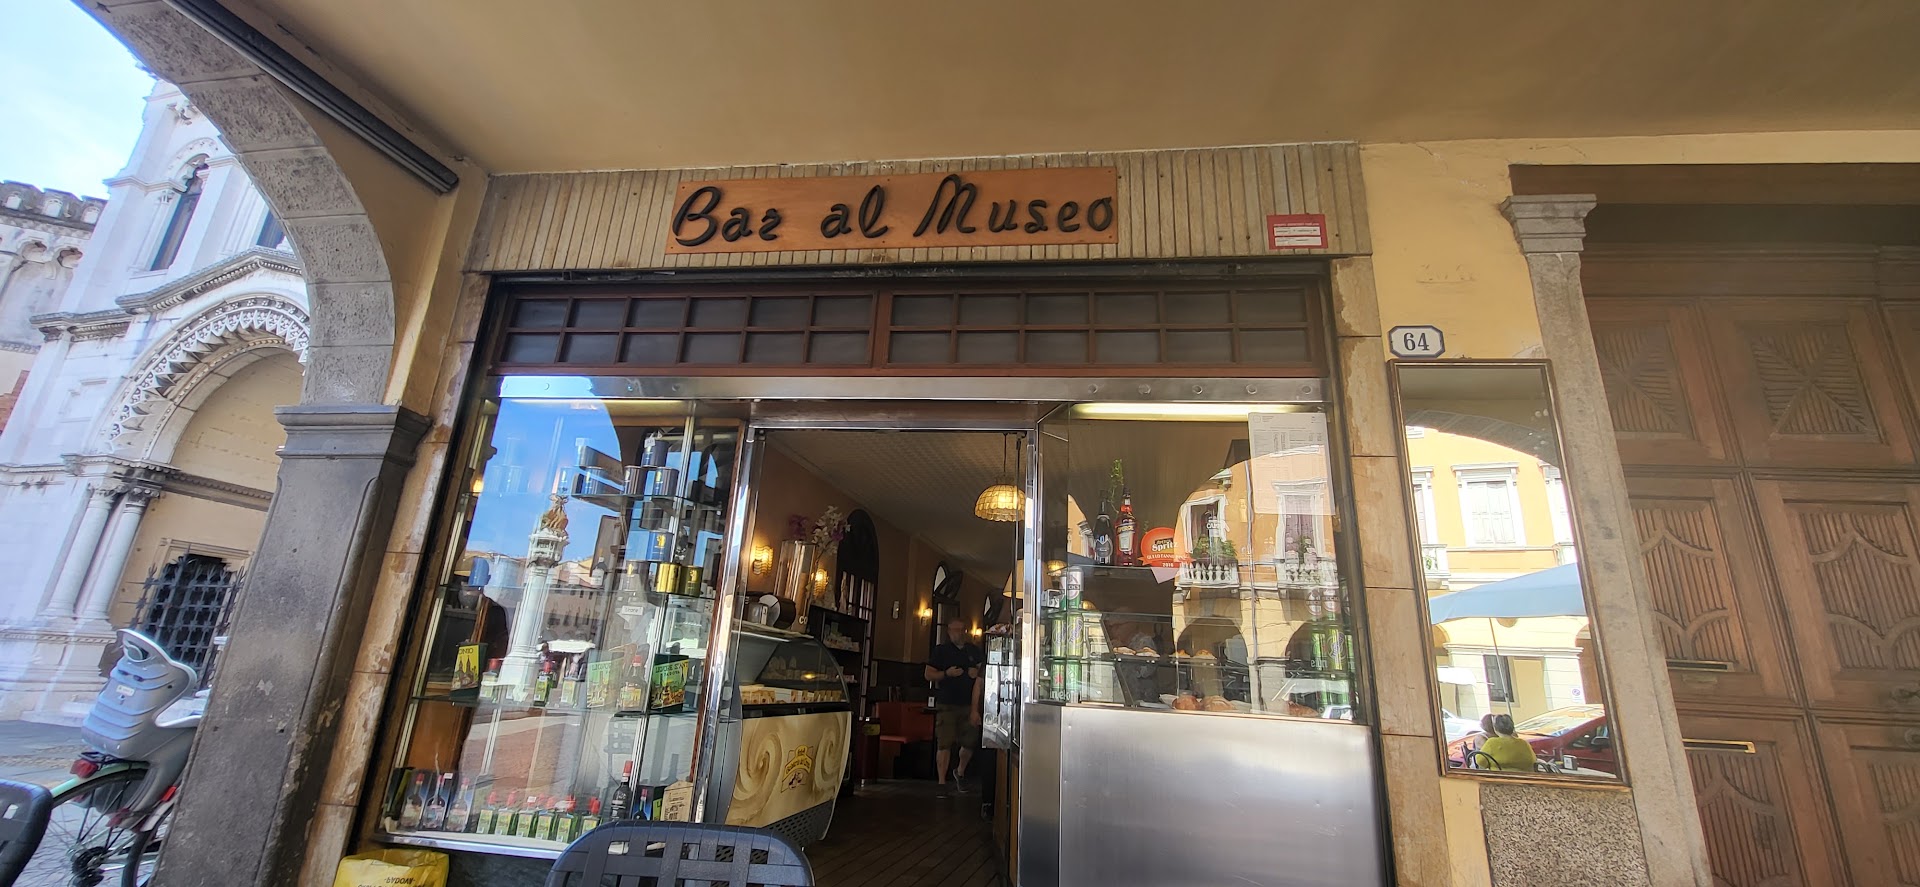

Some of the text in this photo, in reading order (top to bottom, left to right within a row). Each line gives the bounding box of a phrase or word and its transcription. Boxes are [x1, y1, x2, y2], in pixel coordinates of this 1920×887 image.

[672, 173, 1113, 247] Bar al Museo
[1403, 332, 1430, 351] 64
[1151, 541, 1178, 552] Spritz
